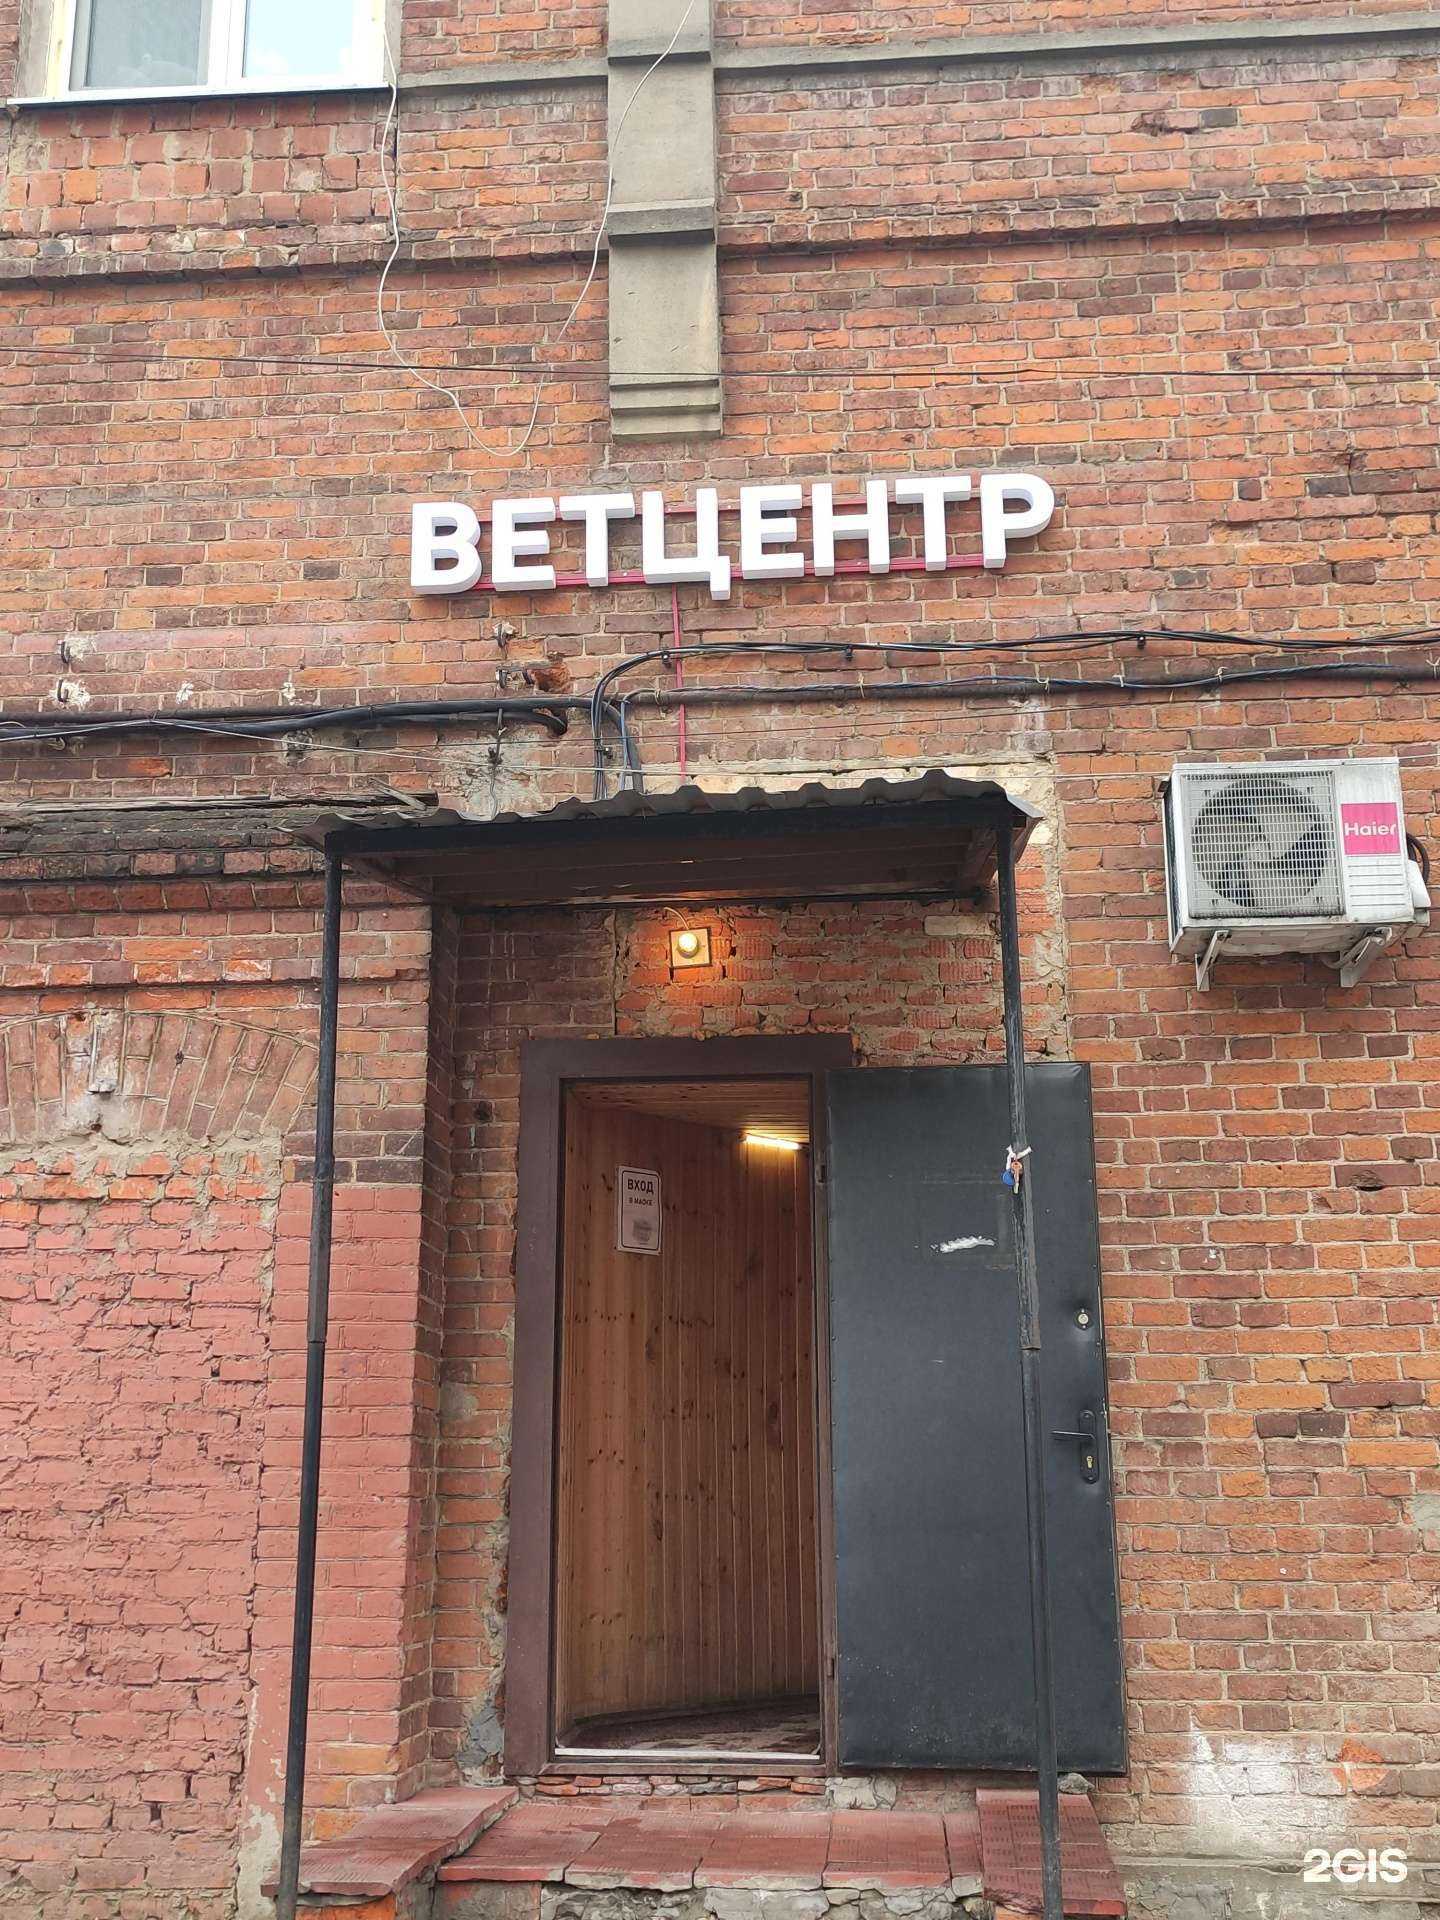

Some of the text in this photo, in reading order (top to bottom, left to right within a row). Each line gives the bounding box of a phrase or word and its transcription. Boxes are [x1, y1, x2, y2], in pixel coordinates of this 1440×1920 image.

[411, 473, 1055, 600] ВЕТЦЕНТР
[1344, 822, 1396, 836] Haier
[627, 1179, 654, 1195] ВХОД
